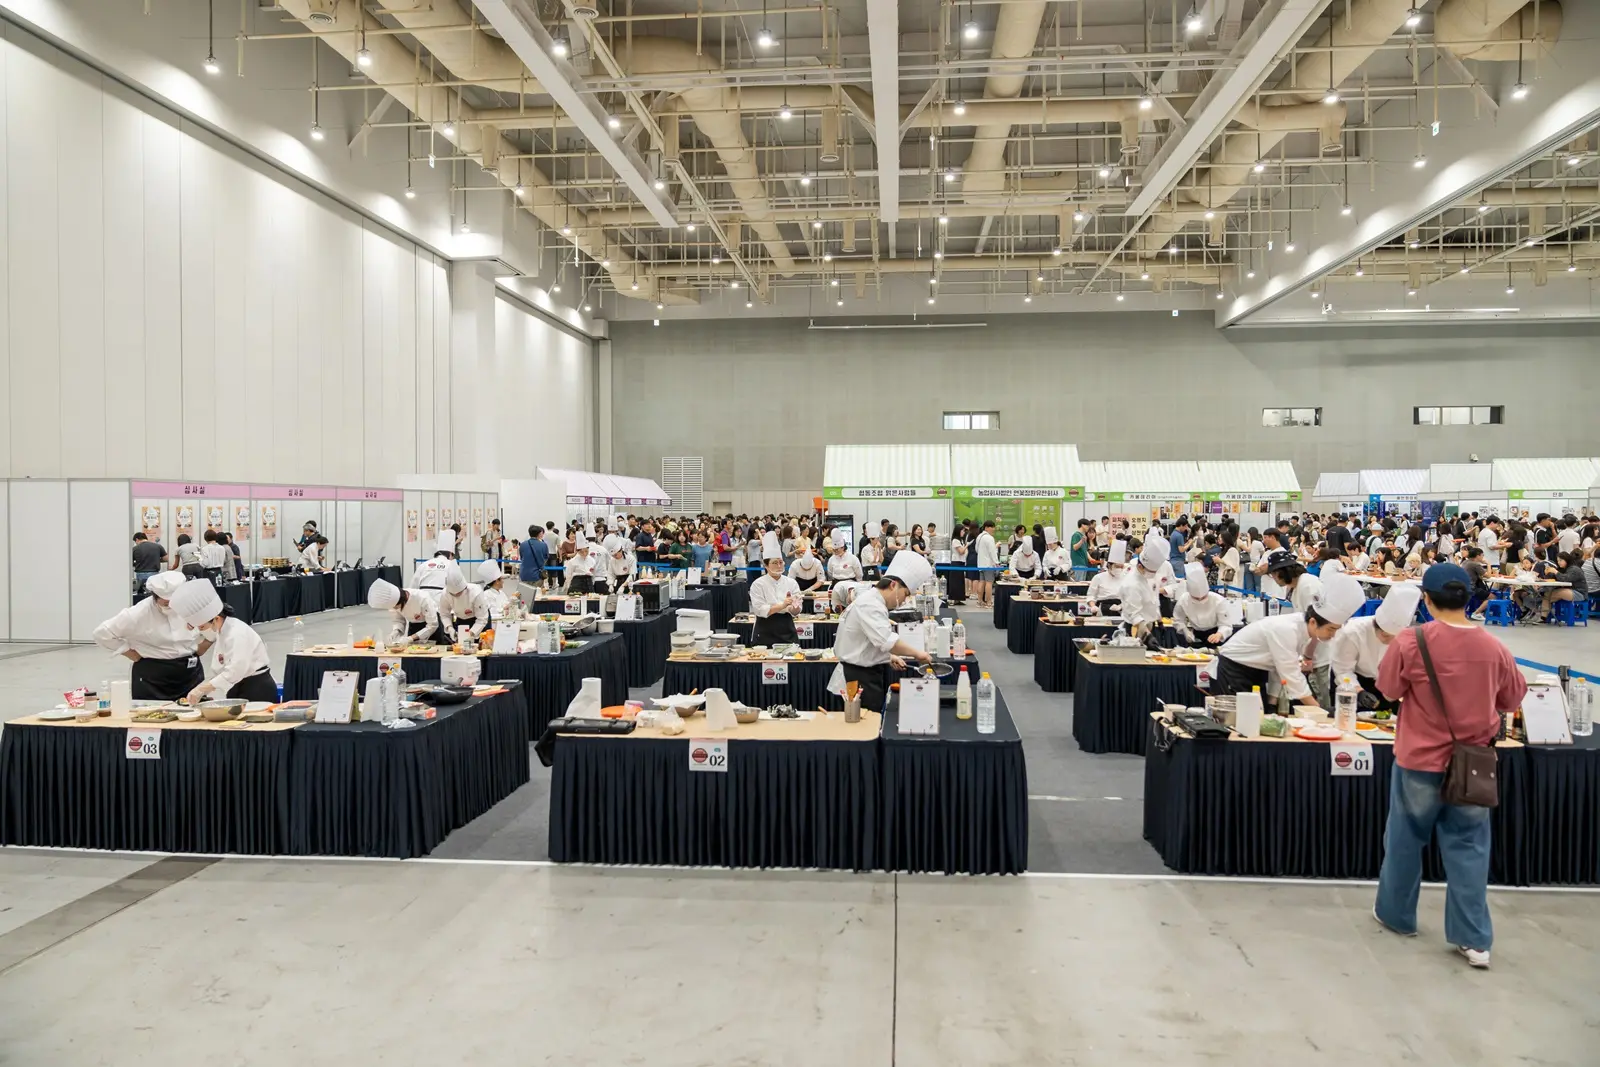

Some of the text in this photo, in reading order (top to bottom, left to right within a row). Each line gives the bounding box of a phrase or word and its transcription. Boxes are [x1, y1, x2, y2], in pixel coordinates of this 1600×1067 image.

[184, 485, 205, 495] 심사실
[775, 672, 787, 681] 05
[143, 743, 157, 755] 03
[709, 754, 726, 767] 02
[1354, 758, 1369, 771] 01
